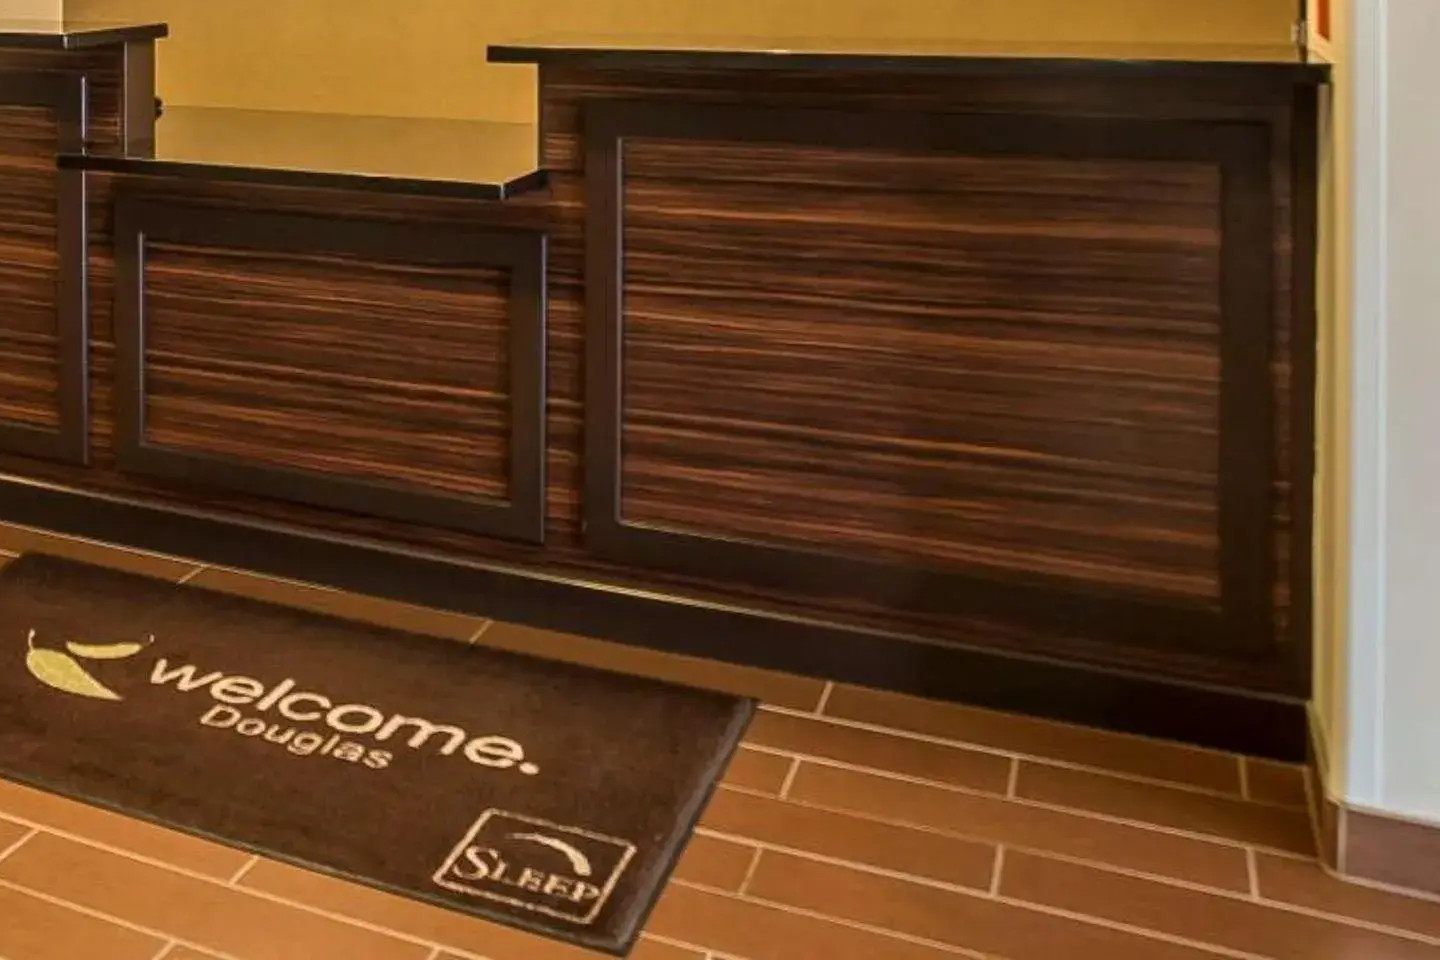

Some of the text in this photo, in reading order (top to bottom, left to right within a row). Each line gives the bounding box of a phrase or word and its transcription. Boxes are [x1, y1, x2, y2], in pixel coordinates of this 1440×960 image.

[149, 657, 540, 776] welcome.
[199, 703, 394, 770] Douglas
[453, 845, 600, 902] SLEEP
